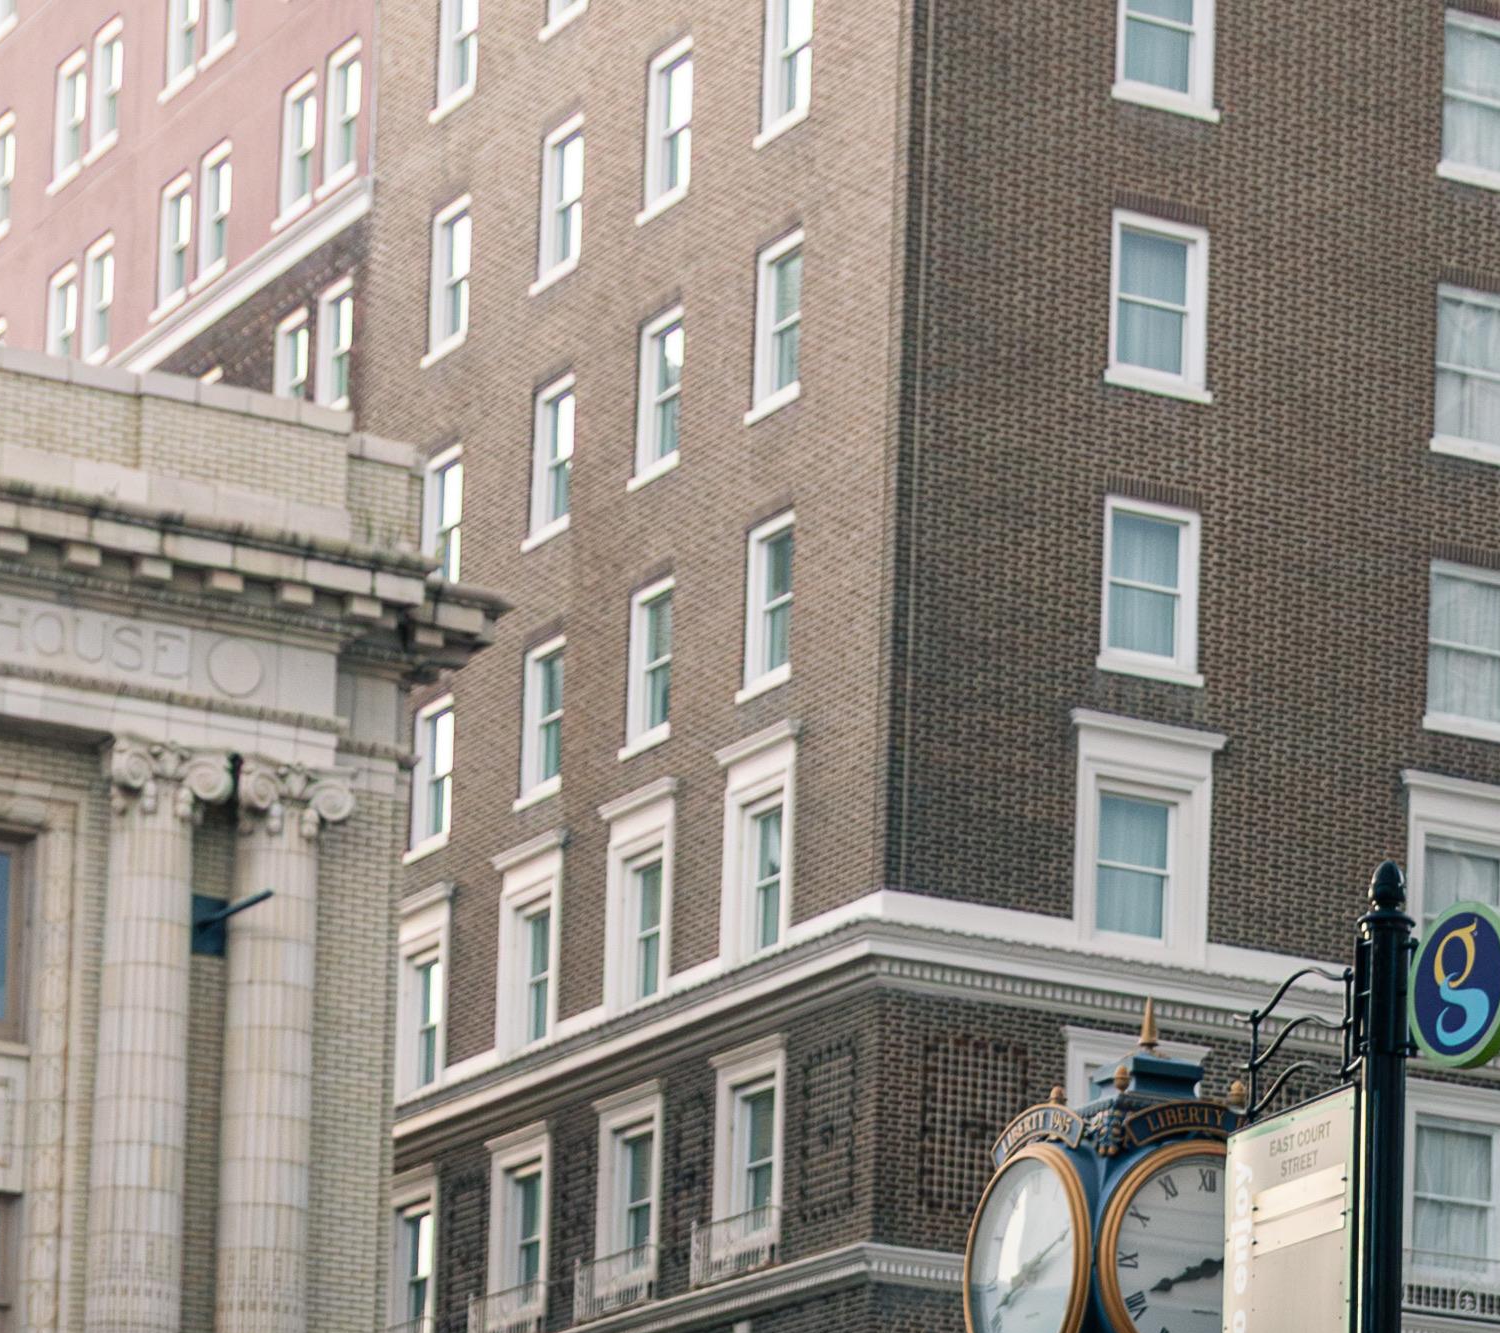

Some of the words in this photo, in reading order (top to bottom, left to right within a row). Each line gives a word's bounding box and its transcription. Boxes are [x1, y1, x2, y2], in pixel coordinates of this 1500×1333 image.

[1001, 1111, 1046, 1153] LIBERTY
[1146, 1106, 1225, 1132] LIBERTY
[1269, 1133, 1295, 1157] EAST
[1297, 1121, 1332, 1147] COURT
[1281, 1149, 1318, 1177] STREET
[1231, 1161, 1253, 1295] enjoy
